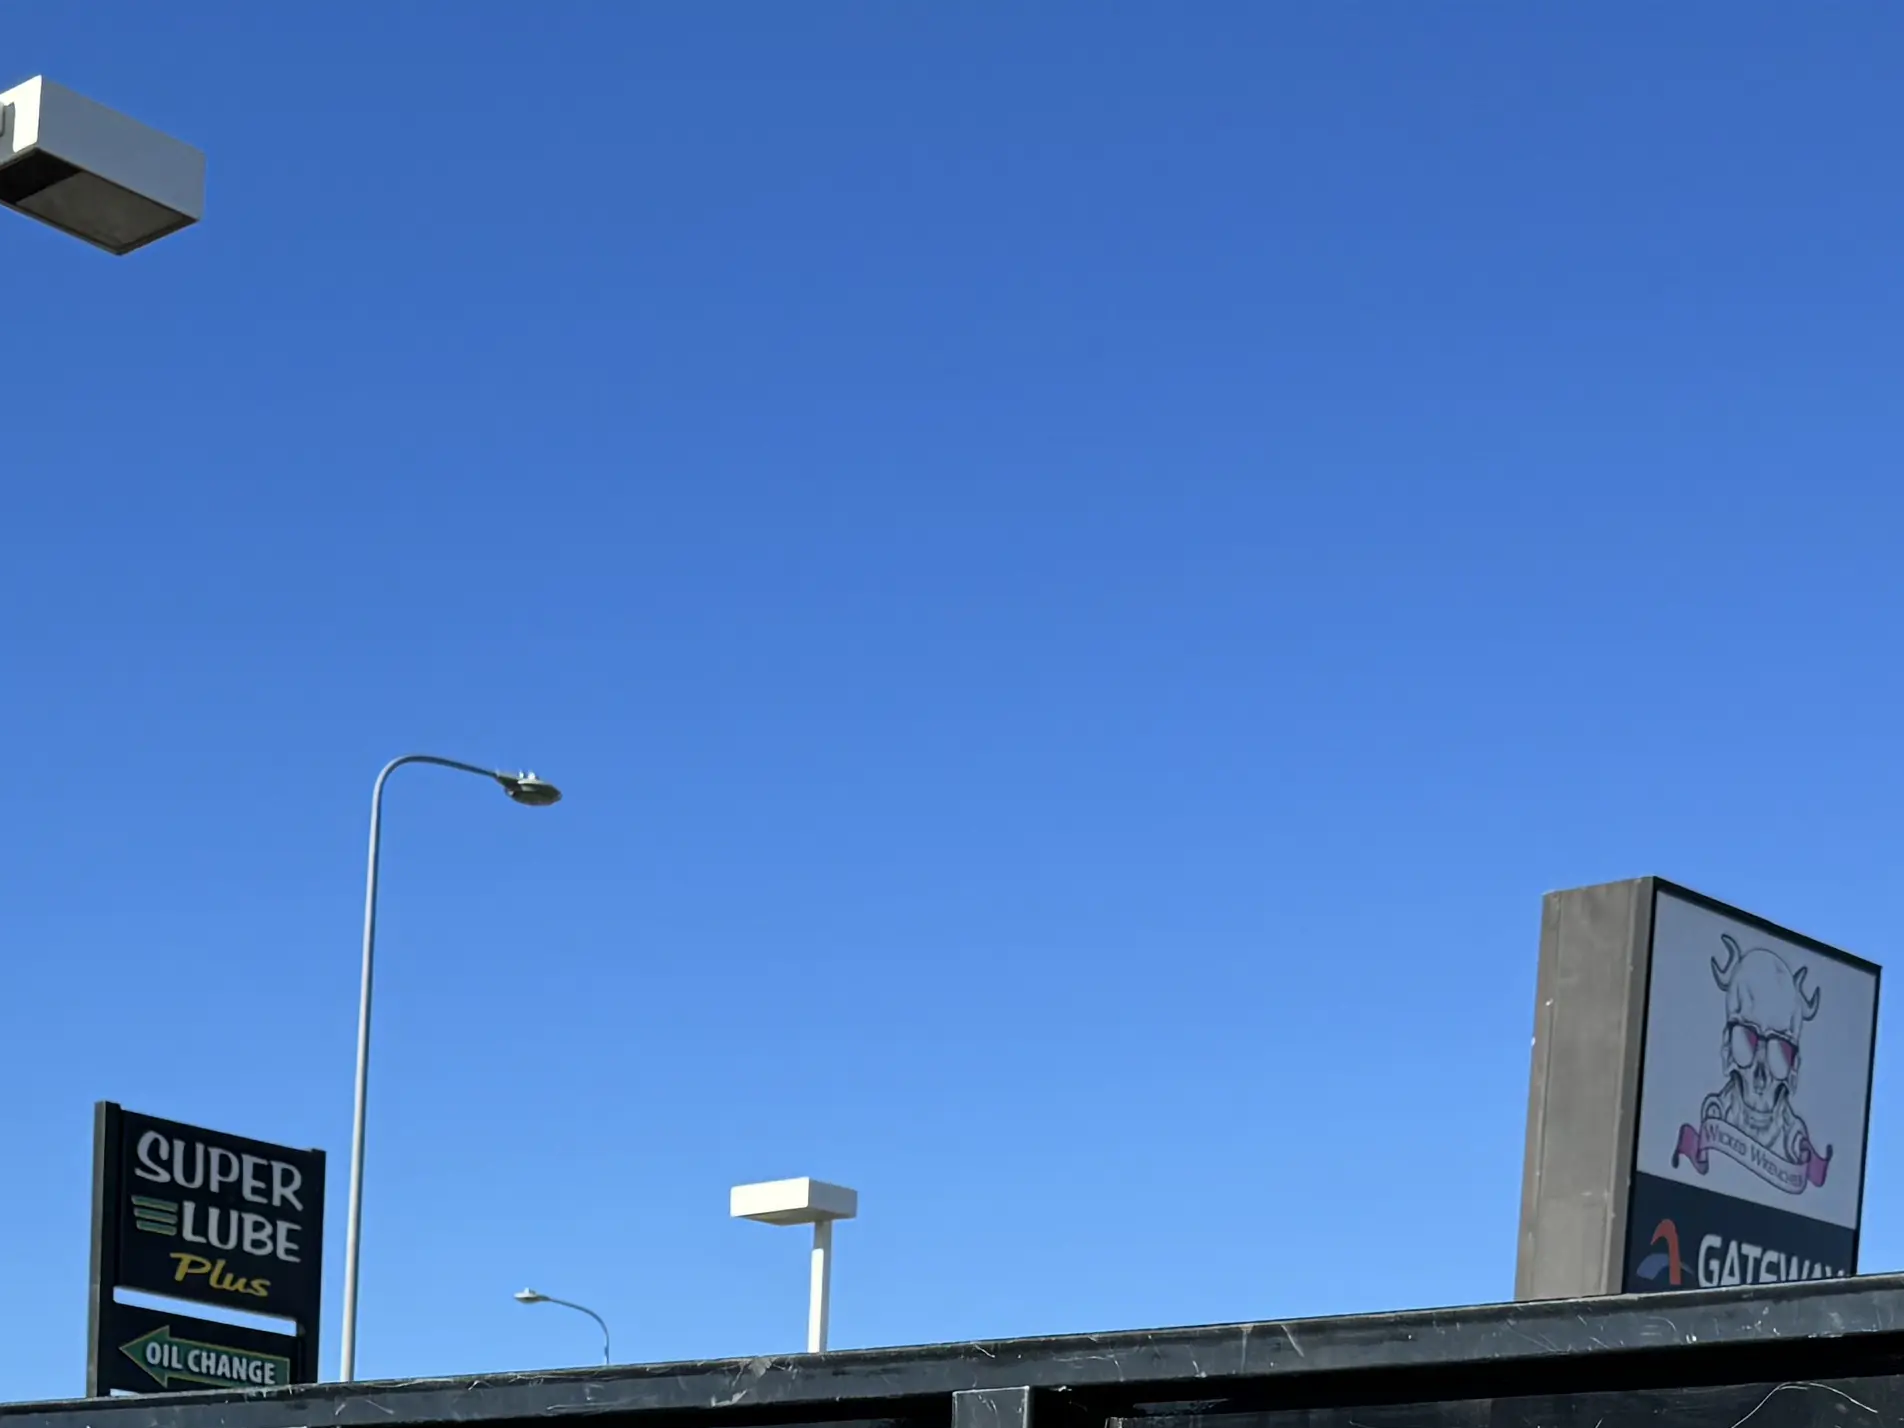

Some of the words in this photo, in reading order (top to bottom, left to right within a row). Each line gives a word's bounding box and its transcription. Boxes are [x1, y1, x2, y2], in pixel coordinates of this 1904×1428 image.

[134, 1130, 303, 1212] SUPER
[182, 1200, 302, 1263] LUBE
[169, 1252, 271, 1297] Plus
[146, 1341, 184, 1371] OIL
[187, 1349, 277, 1385] CHANGE
